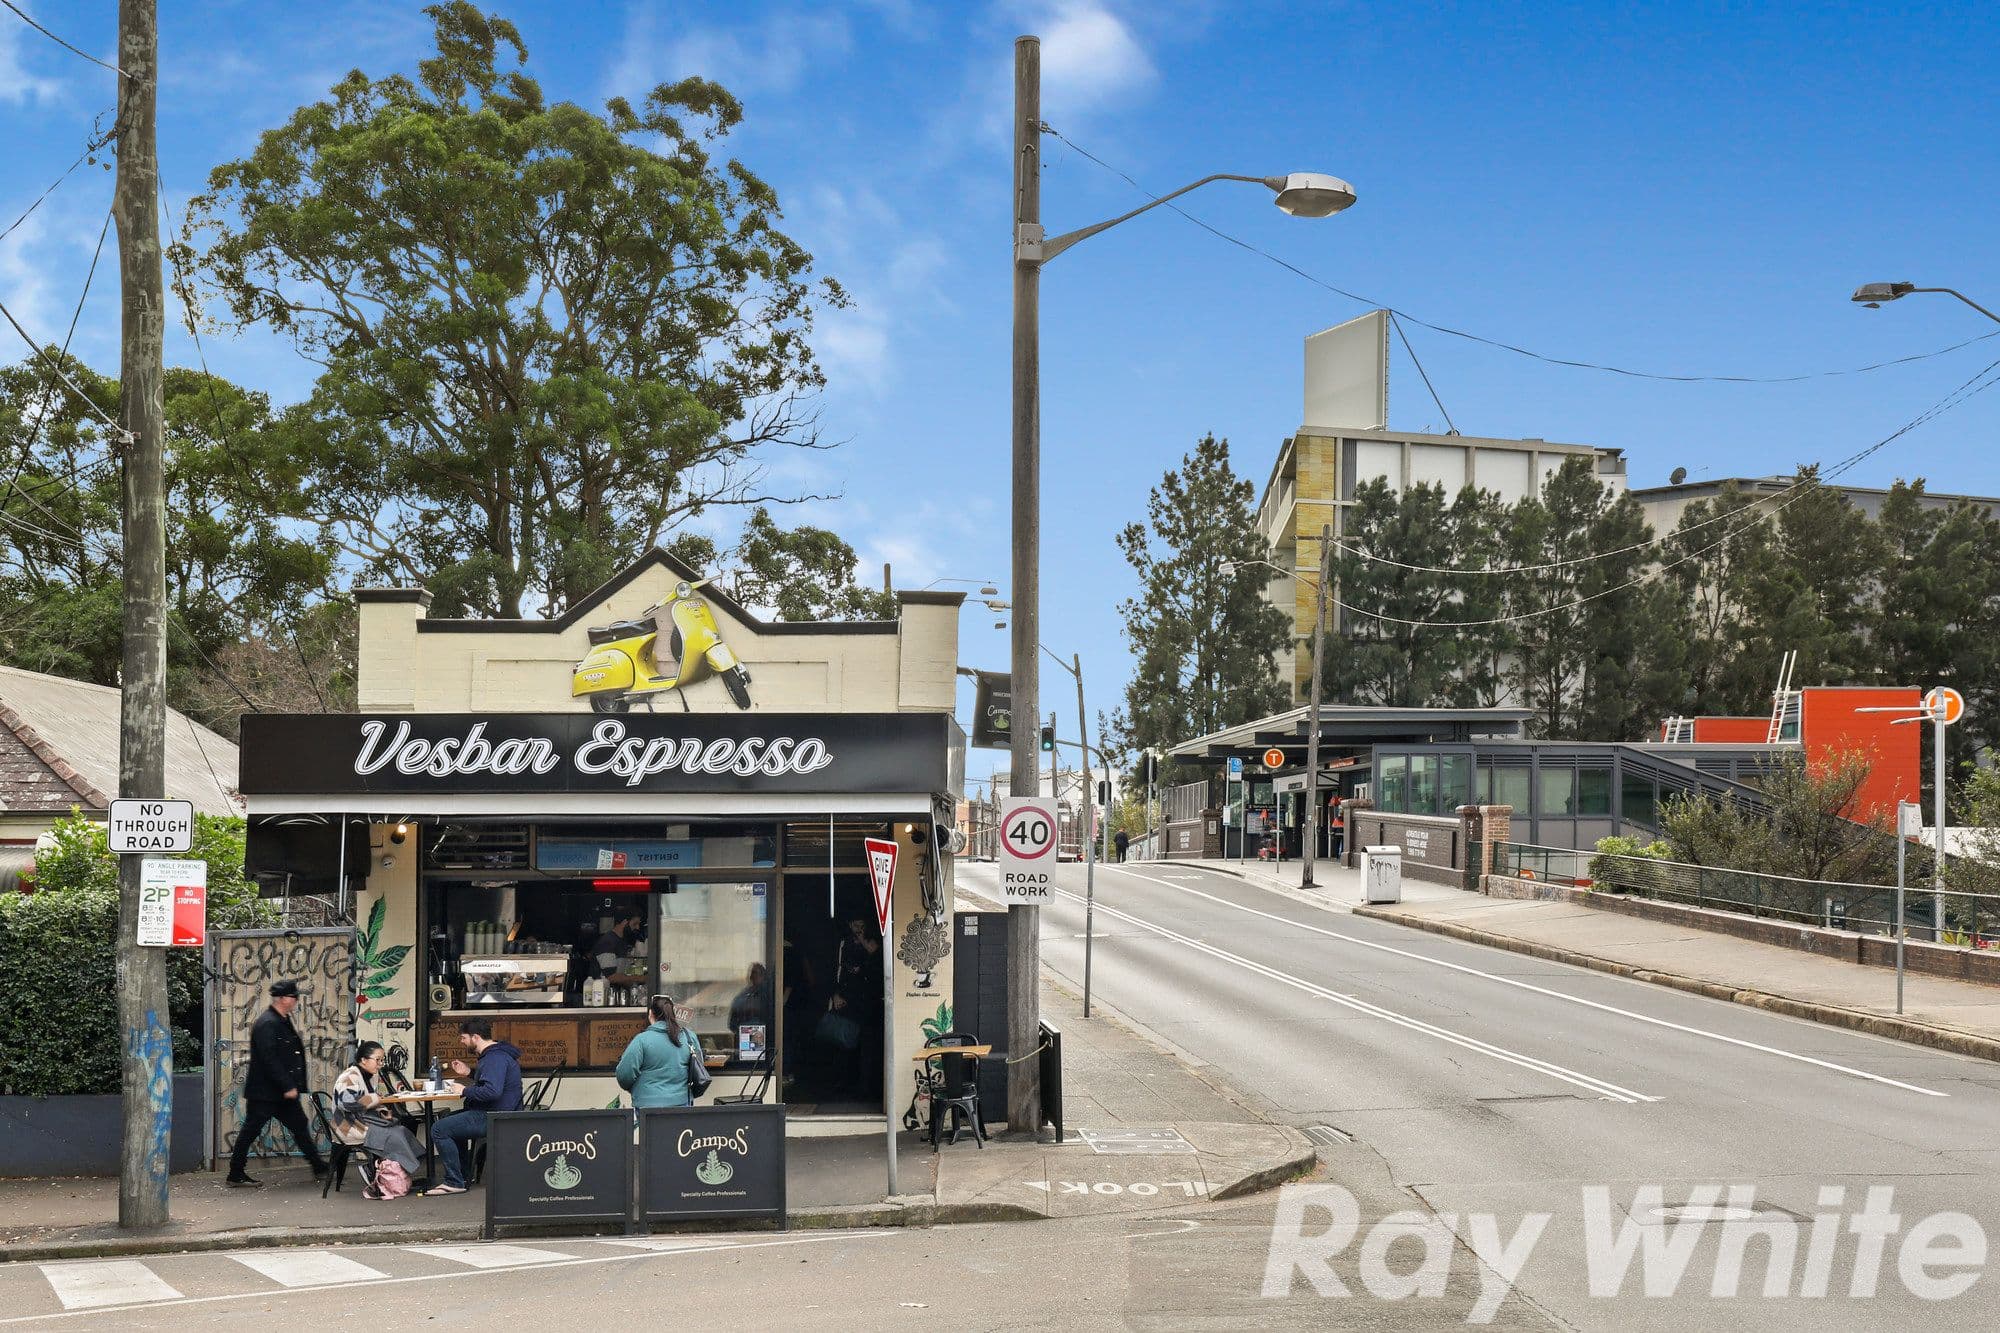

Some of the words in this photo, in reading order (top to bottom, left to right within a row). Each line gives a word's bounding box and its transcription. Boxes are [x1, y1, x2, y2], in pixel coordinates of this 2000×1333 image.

[354, 720, 560, 777] Vesbar
[574, 719, 834, 787] Espresso
[140, 804, 163, 816] NO
[115, 820, 187, 832] THROUGH
[1009, 820, 1048, 845] 40
[126, 836, 174, 848] ROAD
[875, 857, 889, 873] GIVE
[1005, 872, 1048, 884] ROAD
[143, 887, 170, 902] 2P
[184, 889, 194, 897] NO
[1005, 886, 1048, 897] WORK
[177, 897, 201, 905] STOPPING
[1059, 1181, 1196, 1197] LOOK
